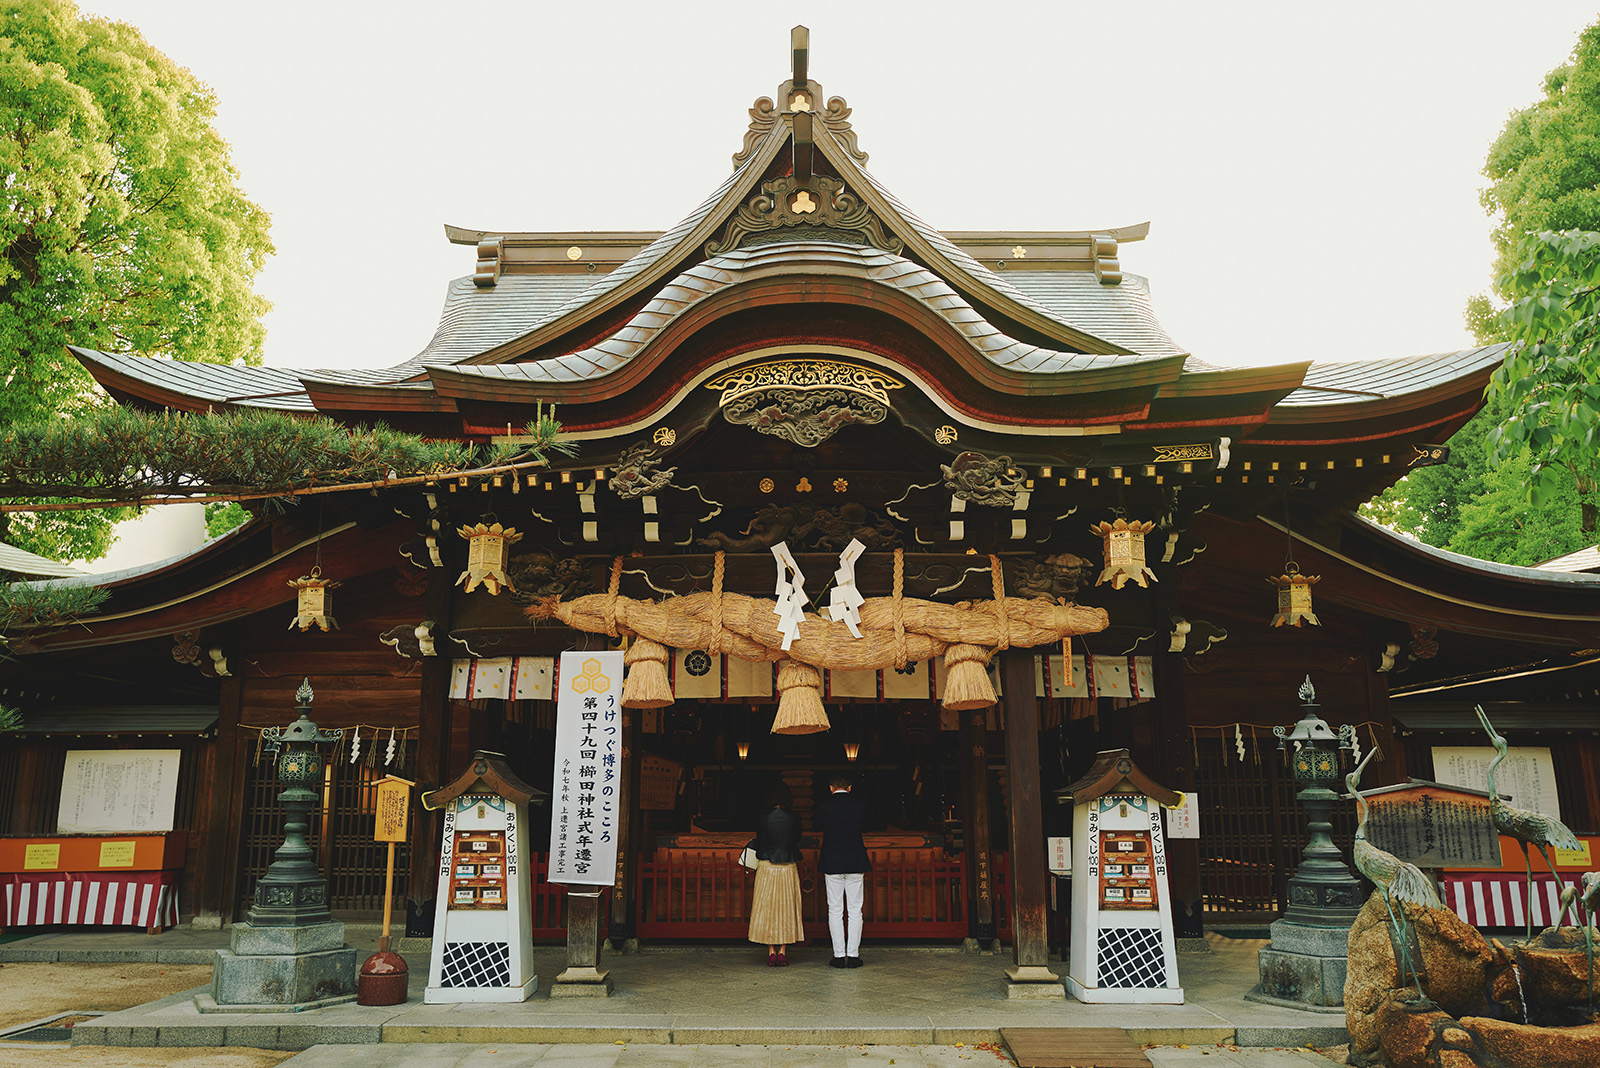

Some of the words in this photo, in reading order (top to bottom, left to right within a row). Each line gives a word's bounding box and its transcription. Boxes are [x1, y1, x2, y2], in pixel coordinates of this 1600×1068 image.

[579, 696, 598, 760] 第四十九回
[560, 758, 571, 802] 令和七年秋
[600, 694, 617, 843] うけつぐ博多のこころ
[440, 812, 455, 876] おみくじ100円
[506, 812, 517, 876] おみくじ100円
[556, 806, 569, 874] 上遷宮諸工事完工
[574, 765, 597, 874] 櫛田神社式年遷宮
[1088, 812, 1099, 876] おみくじ100円
[1150, 812, 1166, 876] おみくじ100円
[1056, 838, 1064, 869] 手指消毒
